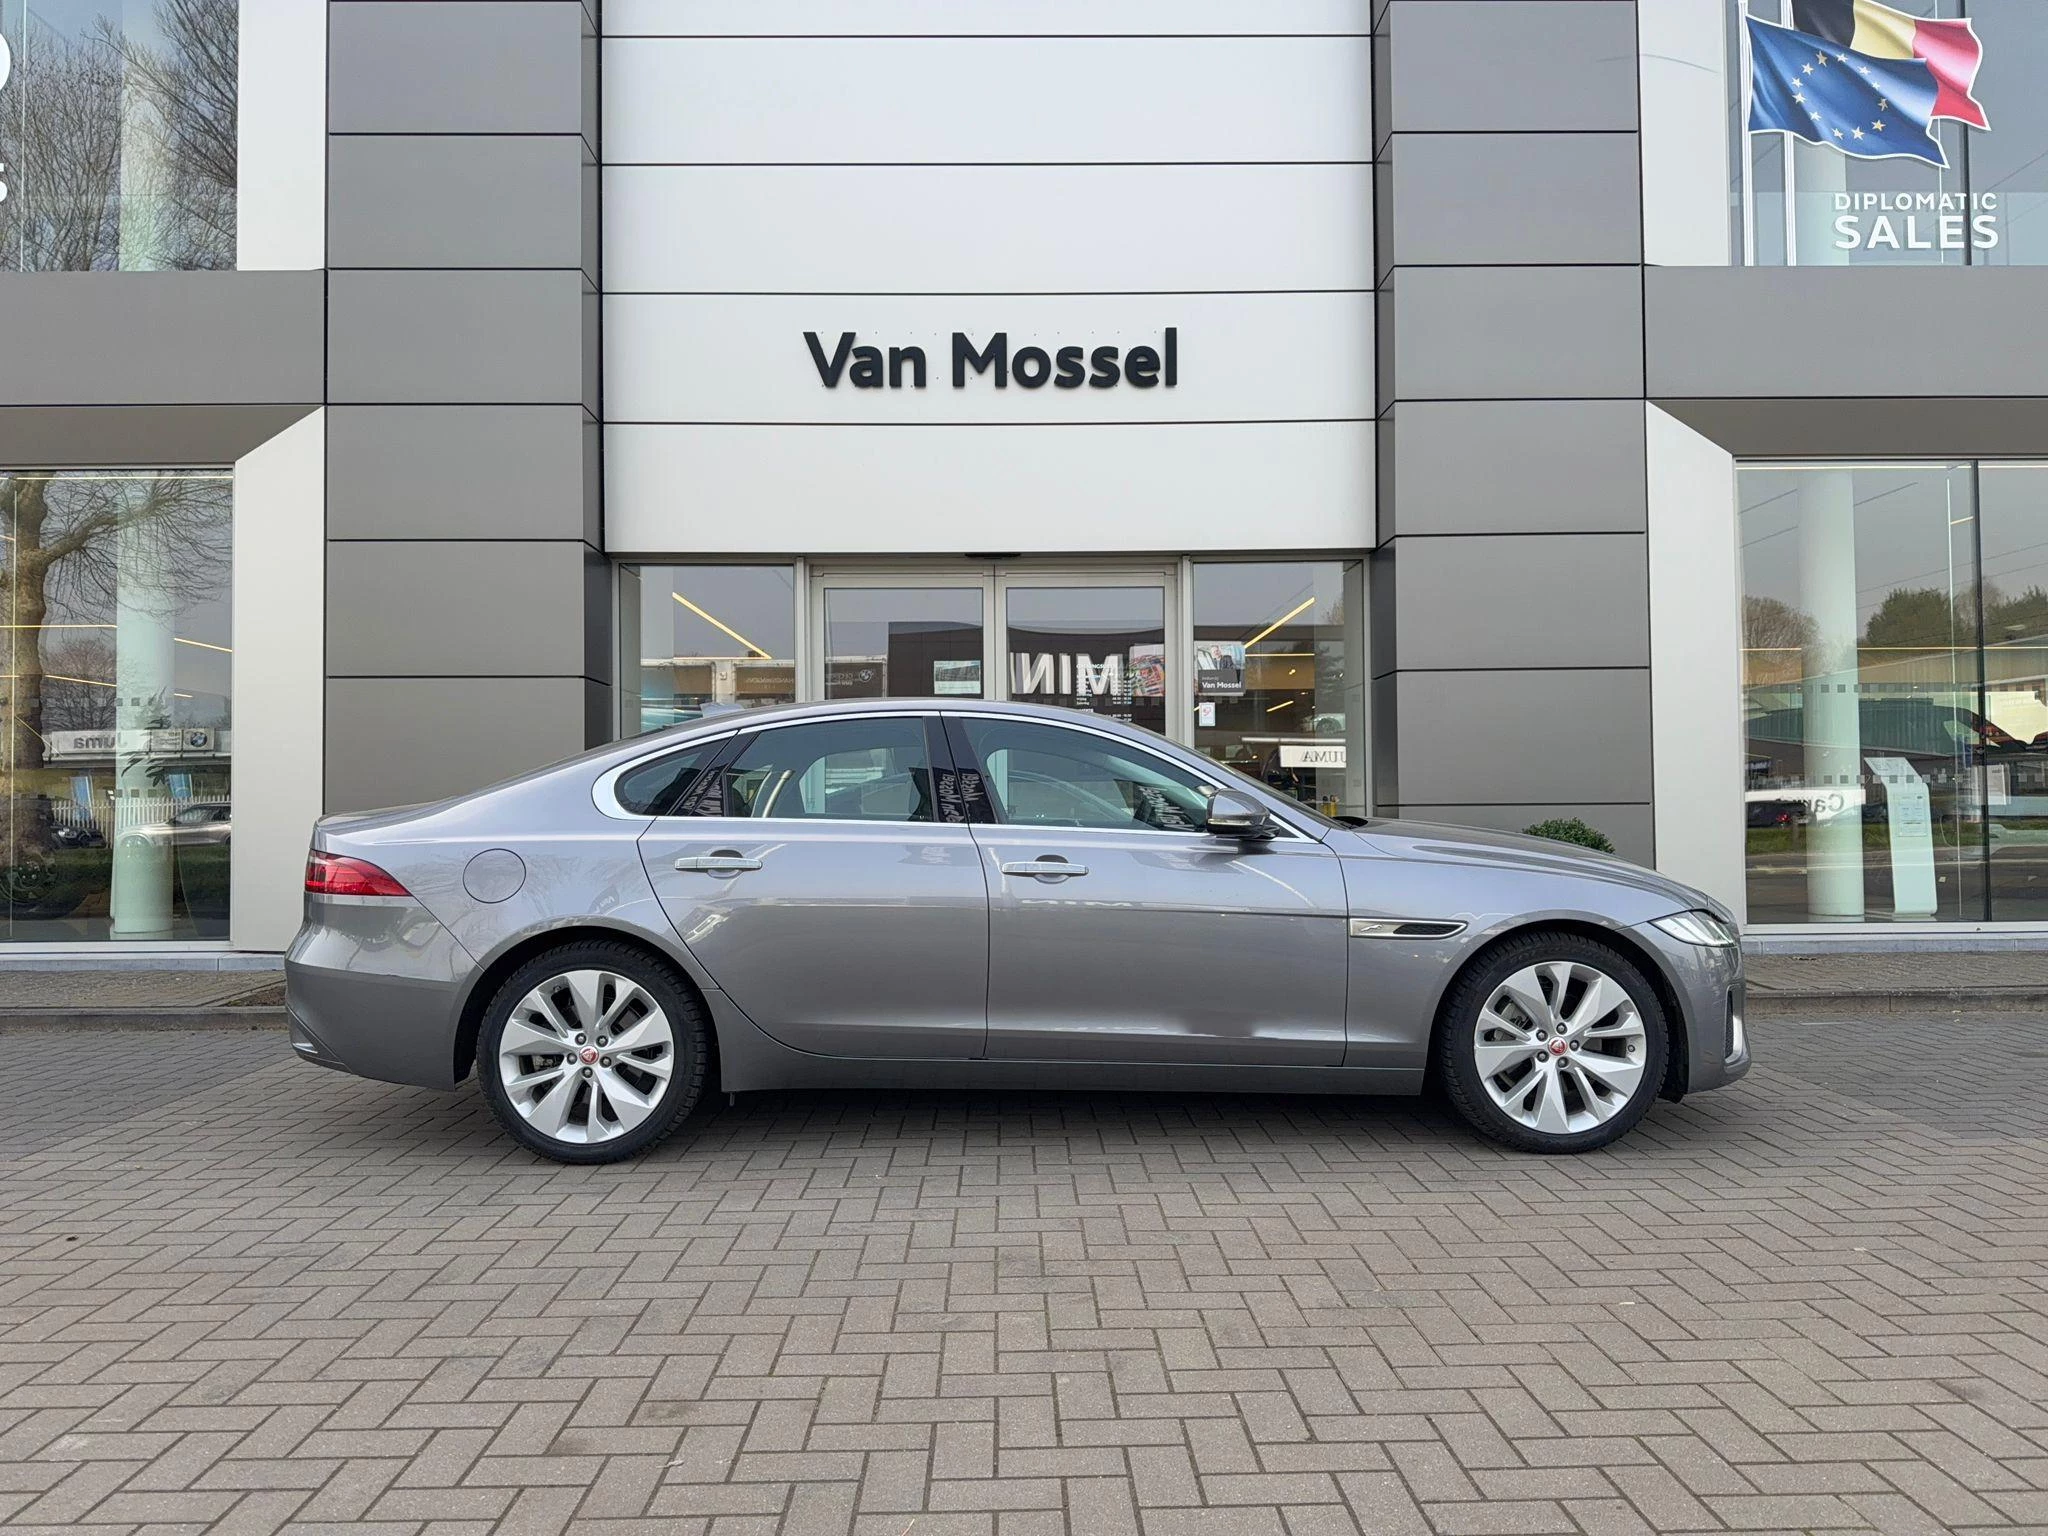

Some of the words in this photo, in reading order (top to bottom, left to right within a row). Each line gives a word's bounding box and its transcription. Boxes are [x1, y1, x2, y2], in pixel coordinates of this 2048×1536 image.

[1834, 192, 1998, 211] DIPLOMATIC
[1834, 214, 2000, 250] SALES
[802, 331, 927, 388] Van
[952, 326, 1178, 388] Mossel
[1201, 681, 1216, 689] Van
[1217, 680, 1242, 689] Mossel
